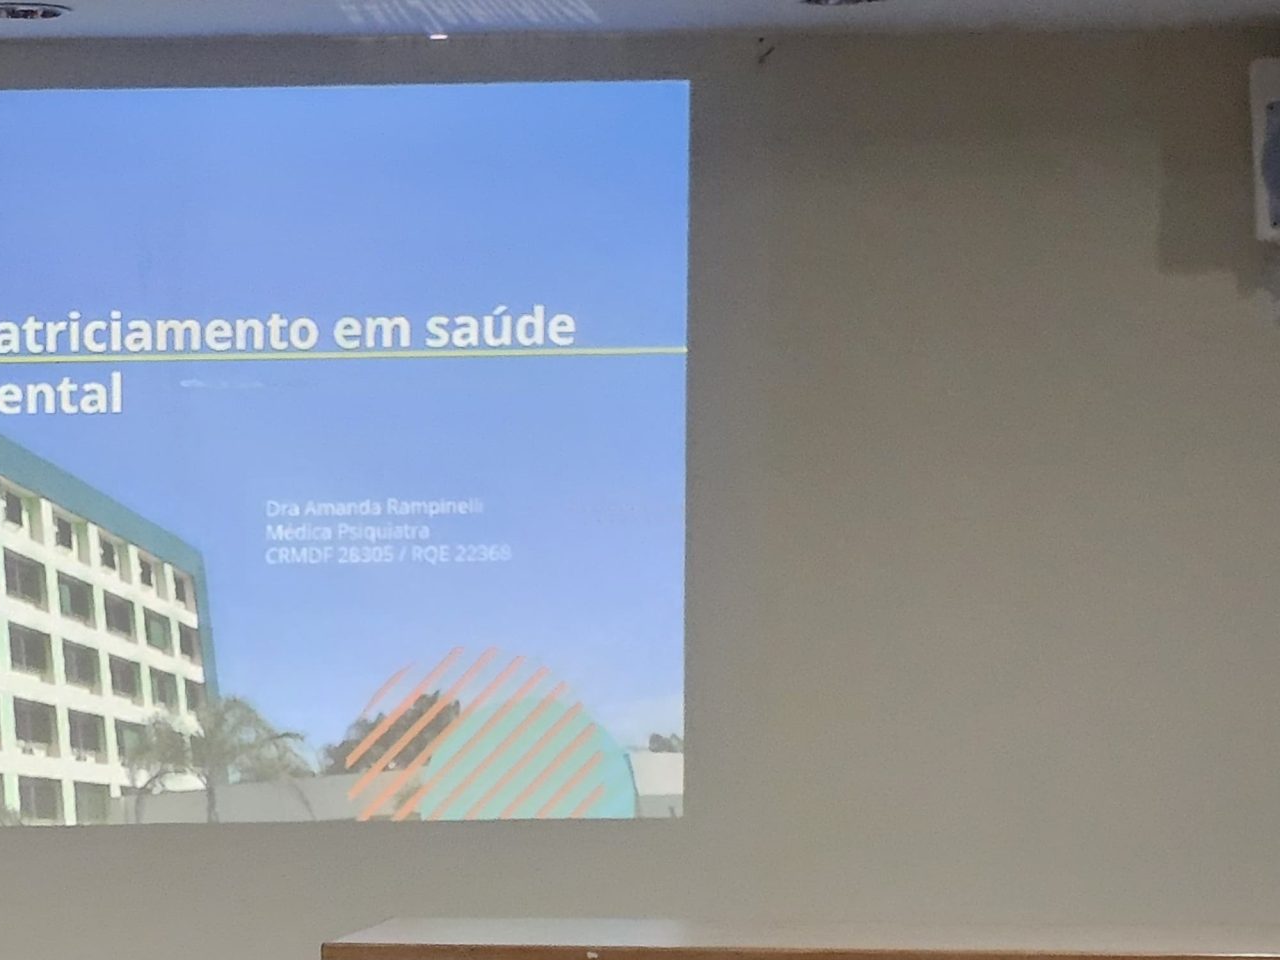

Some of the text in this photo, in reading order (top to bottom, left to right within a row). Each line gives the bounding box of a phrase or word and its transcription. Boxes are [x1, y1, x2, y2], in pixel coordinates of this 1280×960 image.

[333, 314, 412, 350] em
[424, 304, 577, 348] saúde
[266, 497, 485, 517] Dra Amanda Rampinelli
[338, 522, 431, 543] Psiquiatra
[265, 546, 334, 564] CRMDF
[411, 545, 451, 565] RQE
